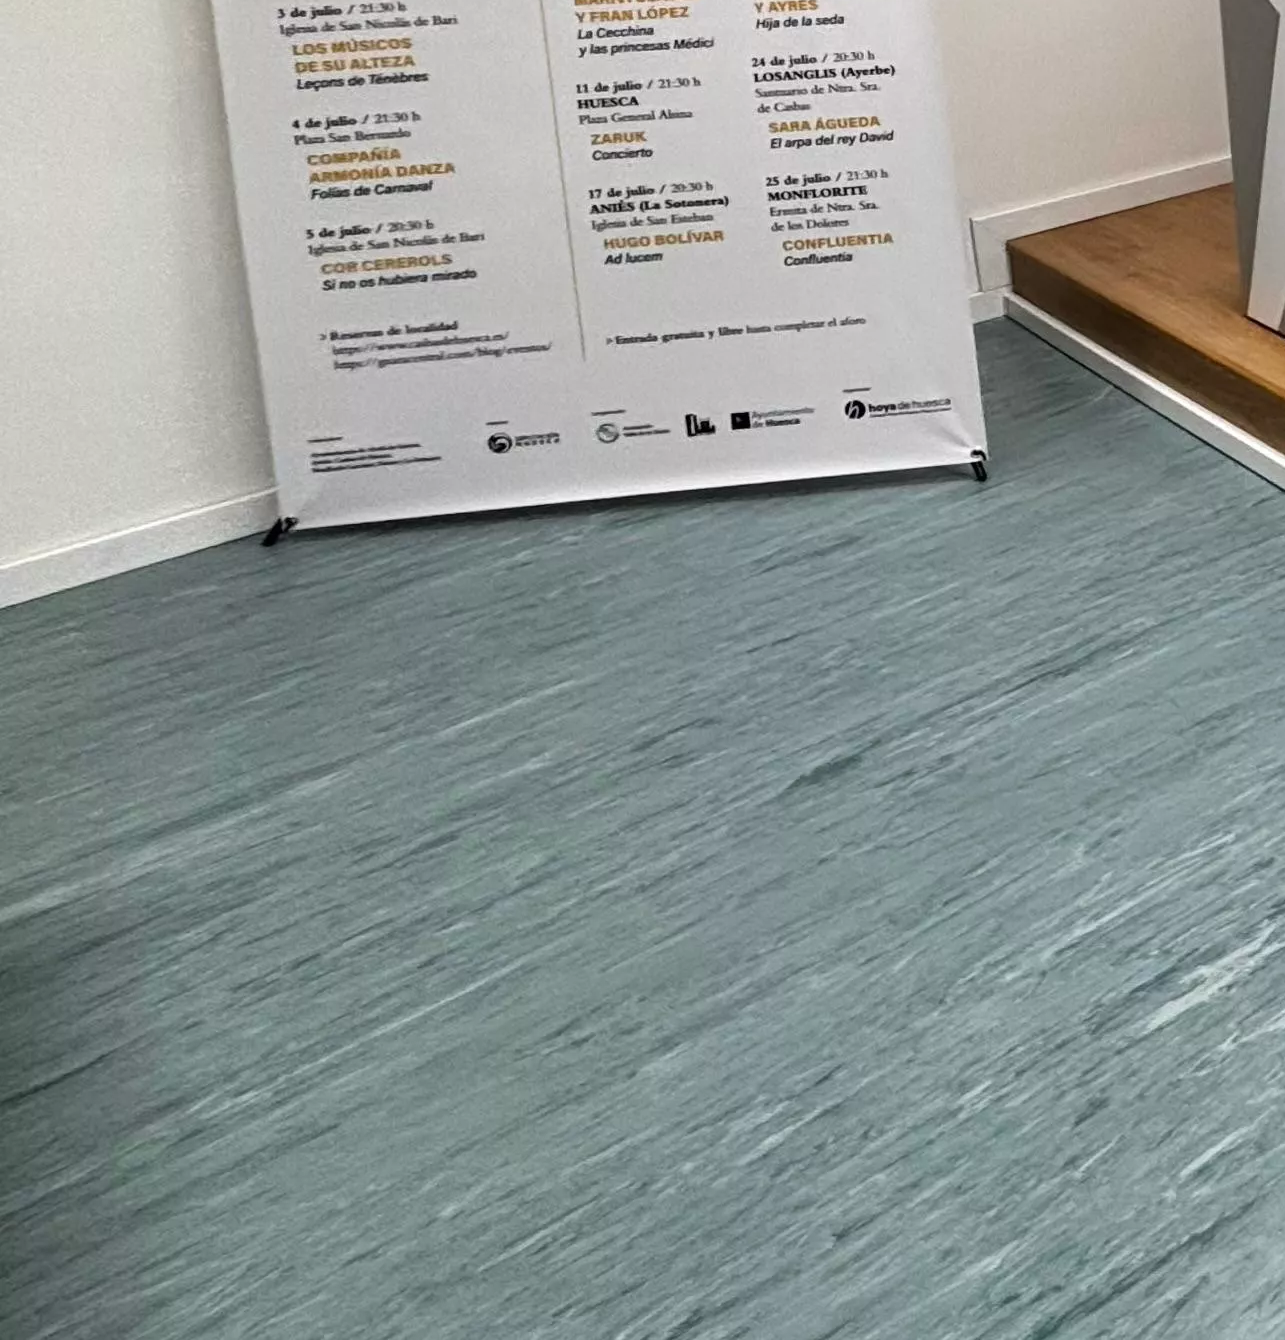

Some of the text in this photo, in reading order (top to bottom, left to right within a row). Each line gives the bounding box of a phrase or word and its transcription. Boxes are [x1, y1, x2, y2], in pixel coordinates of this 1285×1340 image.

[754, 0, 818, 13] Y AYRES
[575, 6, 689, 23] Y FRAN LÓPEZ
[756, 14, 844, 31] Hija de la seda
[577, 29, 592, 39] La
[579, 47, 587, 58] y
[590, 44, 608, 54] las
[611, 42, 670, 56] princesas
[752, 58, 765, 67] 24
[770, 56, 785, 66] de
[788, 55, 817, 67] julio
[754, 65, 895, 82] LOSANGLIS (Ayerbe)
[576, 84, 588, 94] 11
[594, 82, 609, 92] de
[612, 81, 642, 93] julio
[577, 96, 639, 109] HUESCA
[769, 116, 881, 133] SARA ÁGUEDA
[591, 131, 647, 145] ZARUK
[771, 130, 894, 149] El arpa del rey David
[592, 148, 653, 161] Concierto
[766, 176, 780, 187] 25
[784, 175, 799, 185] de
[802, 173, 831, 186] julio
[589, 189, 602, 199] 17
[607, 188, 622, 197] de
[625, 186, 655, 198] julio
[768, 185, 867, 201] MONFLORITE
[639, 201, 661, 212] (La
[604, 230, 724, 249] HUGO BOLÍVAR
[783, 233, 893, 251] CONFLUENTIA
[604, 253, 622, 264] Ad
